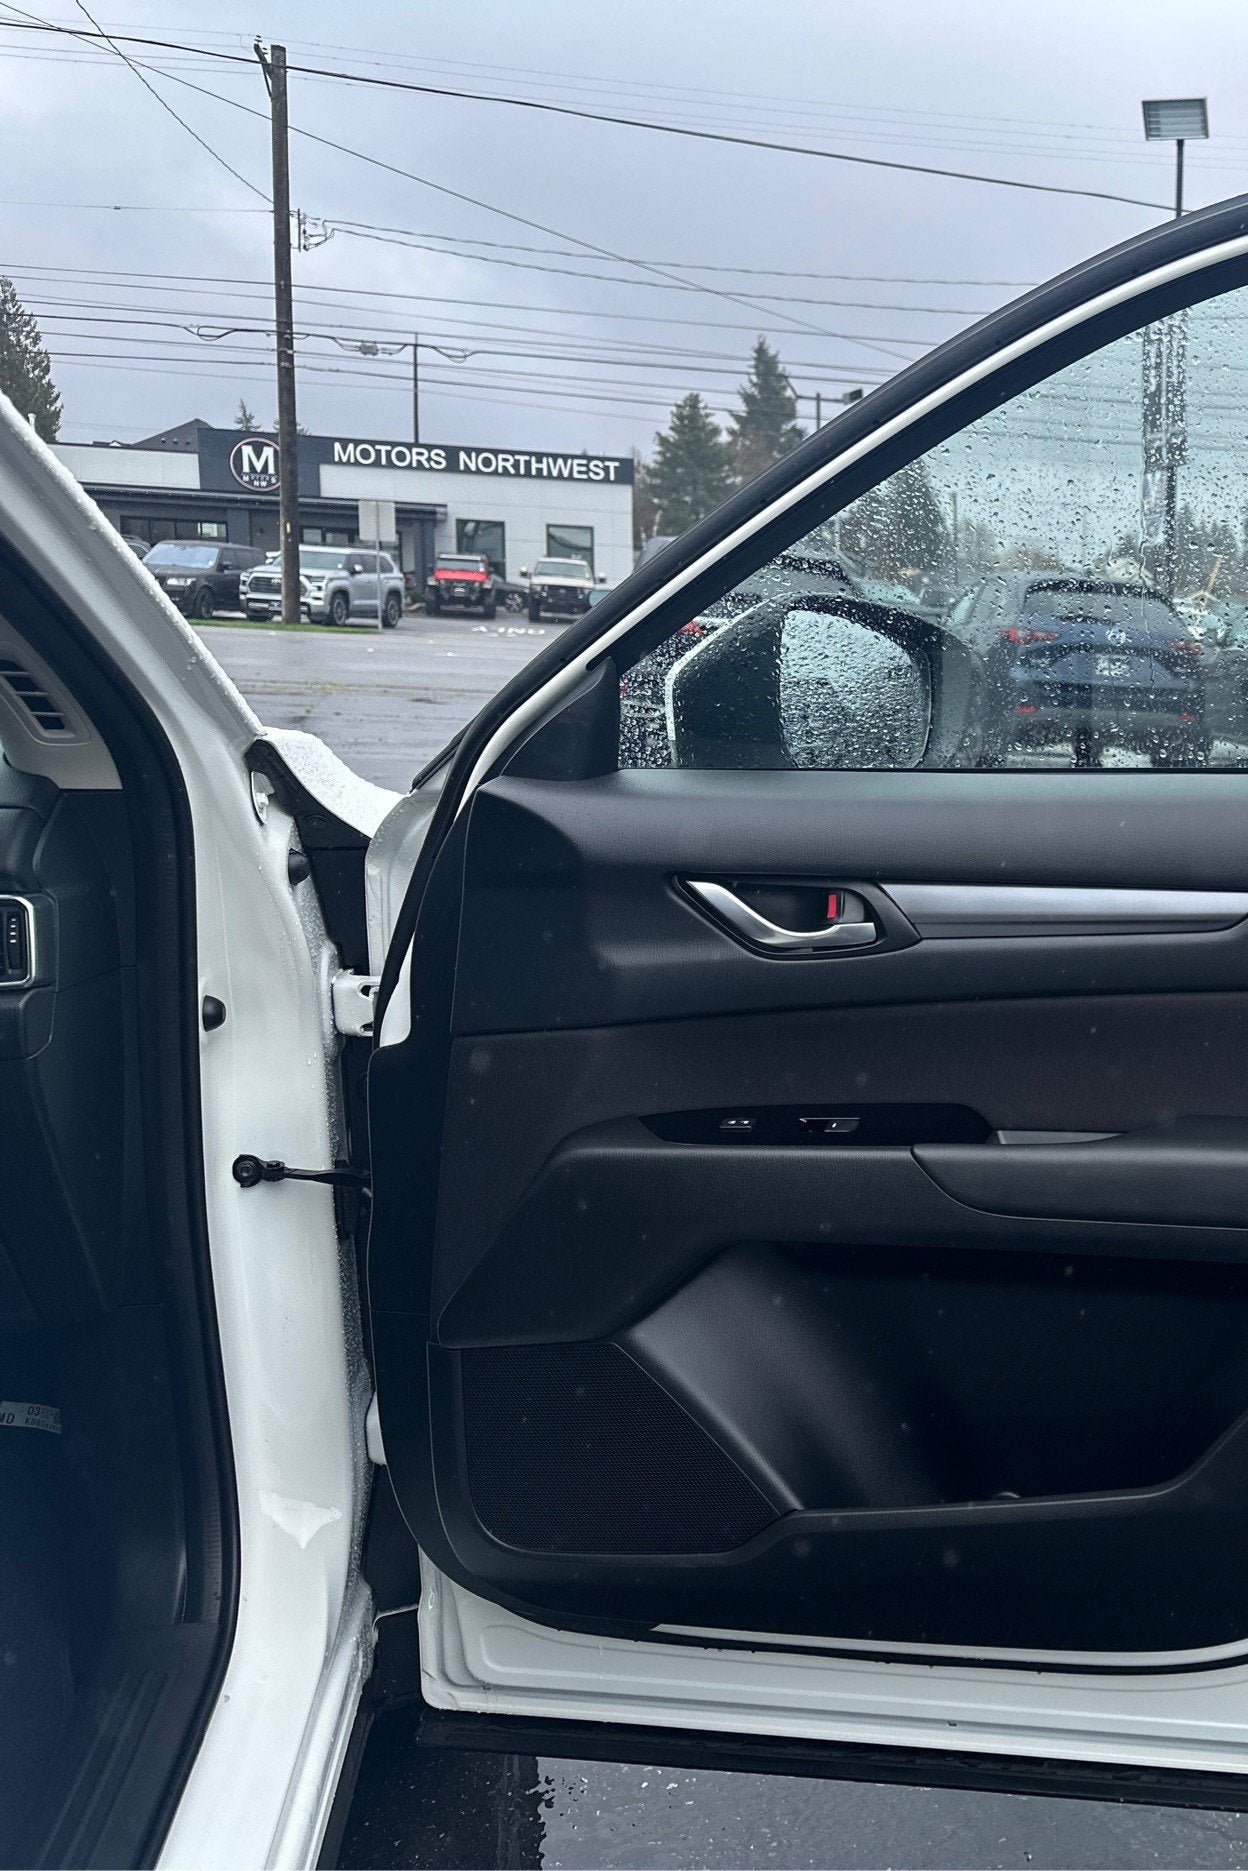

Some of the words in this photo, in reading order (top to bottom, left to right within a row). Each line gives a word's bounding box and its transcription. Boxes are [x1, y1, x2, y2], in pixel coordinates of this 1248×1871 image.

[241, 444, 275, 475] M
[333, 441, 447, 470] MOTORS
[458, 450, 620, 482] NORTHWEST
